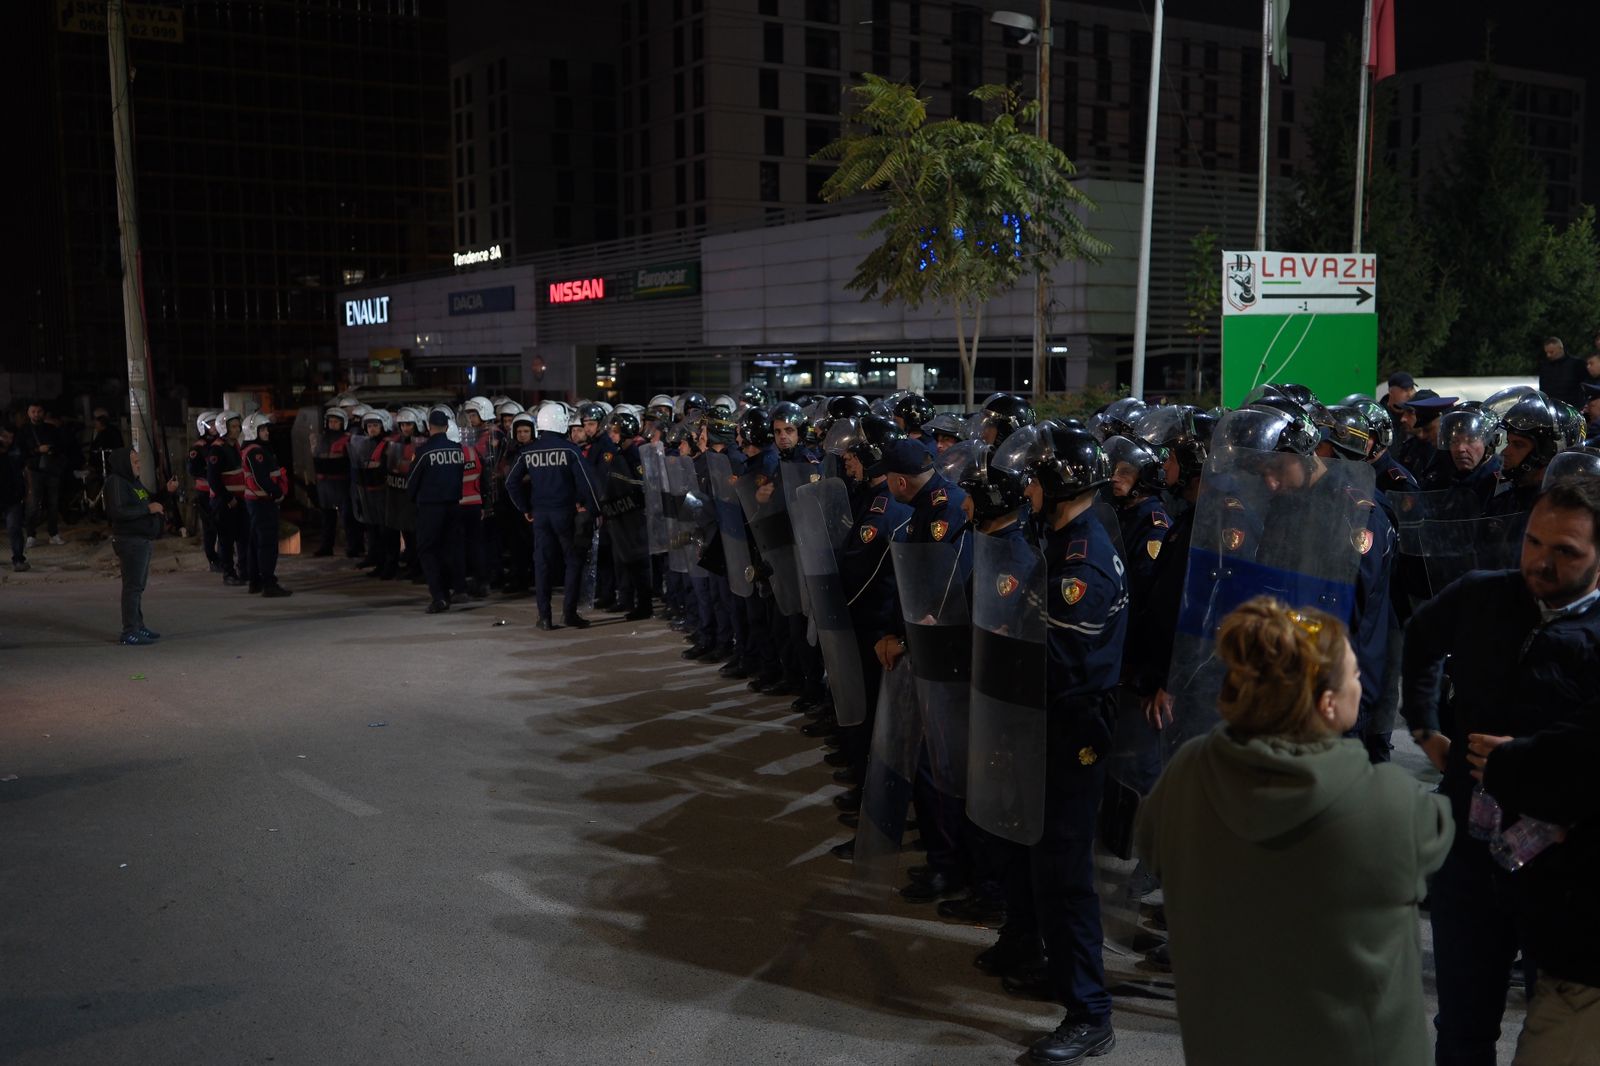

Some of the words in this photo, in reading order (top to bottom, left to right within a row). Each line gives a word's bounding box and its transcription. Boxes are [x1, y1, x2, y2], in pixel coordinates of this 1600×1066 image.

[489, 244, 502, 260] 3A
[1262, 256, 1376, 278] LAVAZH
[637, 268, 688, 288] Europcar
[550, 277, 604, 304] NISSAN
[453, 294, 484, 310] DACIA
[429, 451, 465, 467] POLICIA
[525, 451, 568, 468] POLICIA
